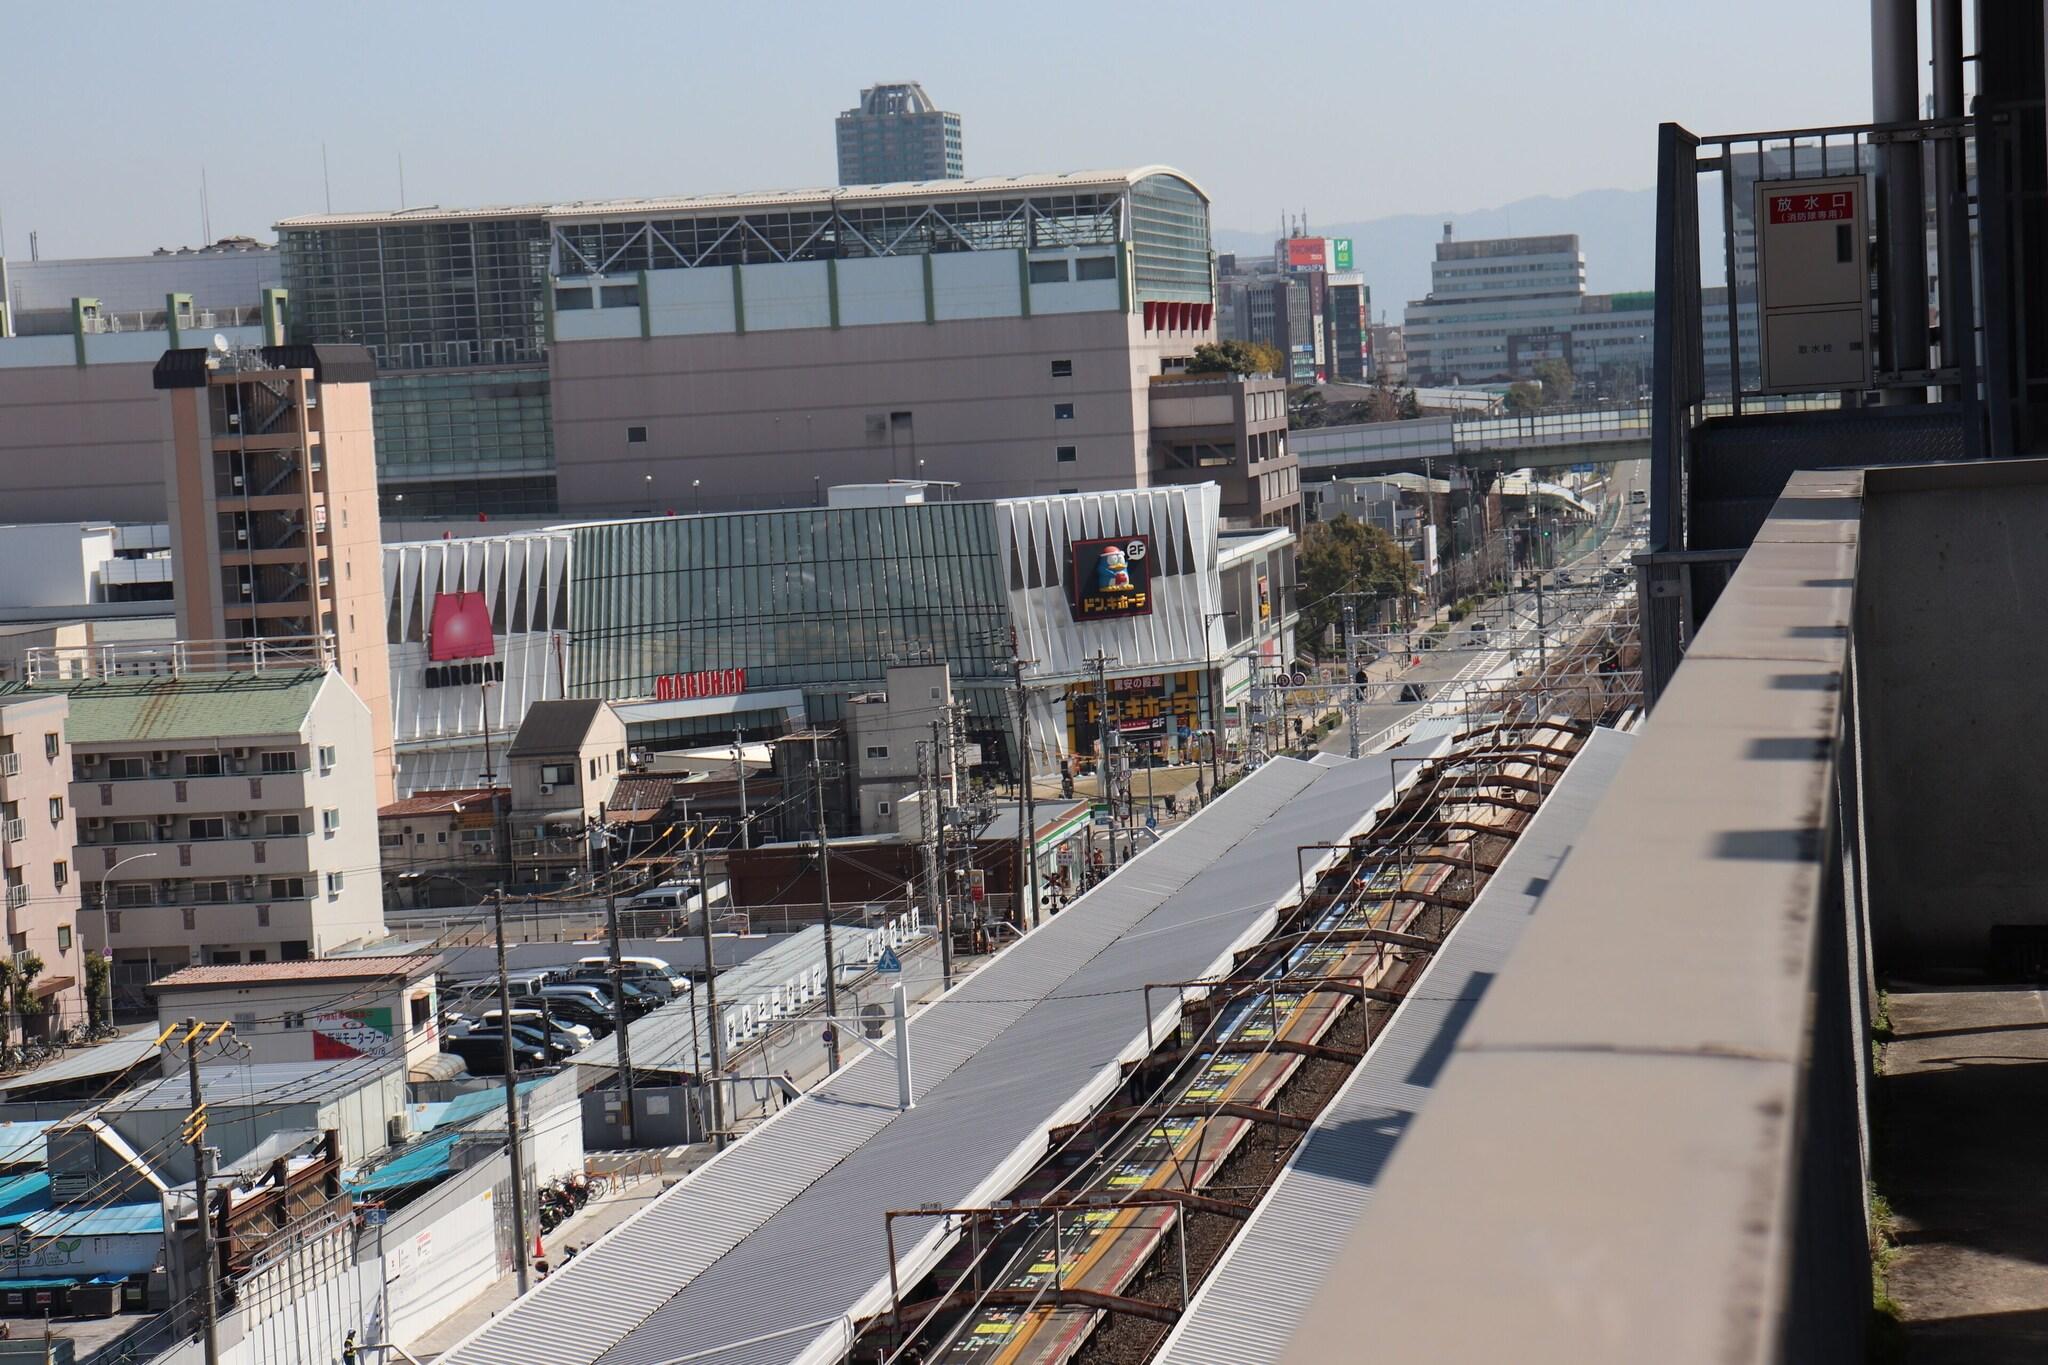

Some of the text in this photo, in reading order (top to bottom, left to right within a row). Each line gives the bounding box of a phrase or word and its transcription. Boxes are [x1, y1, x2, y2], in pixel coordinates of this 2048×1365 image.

[1777, 194, 1846, 212] 放水口
[1129, 544, 1144, 555] 2F
[425, 661, 504, 688] MARUHAN
[655, 667, 746, 702] MARUHAN
[1151, 717, 1165, 729] 2F
